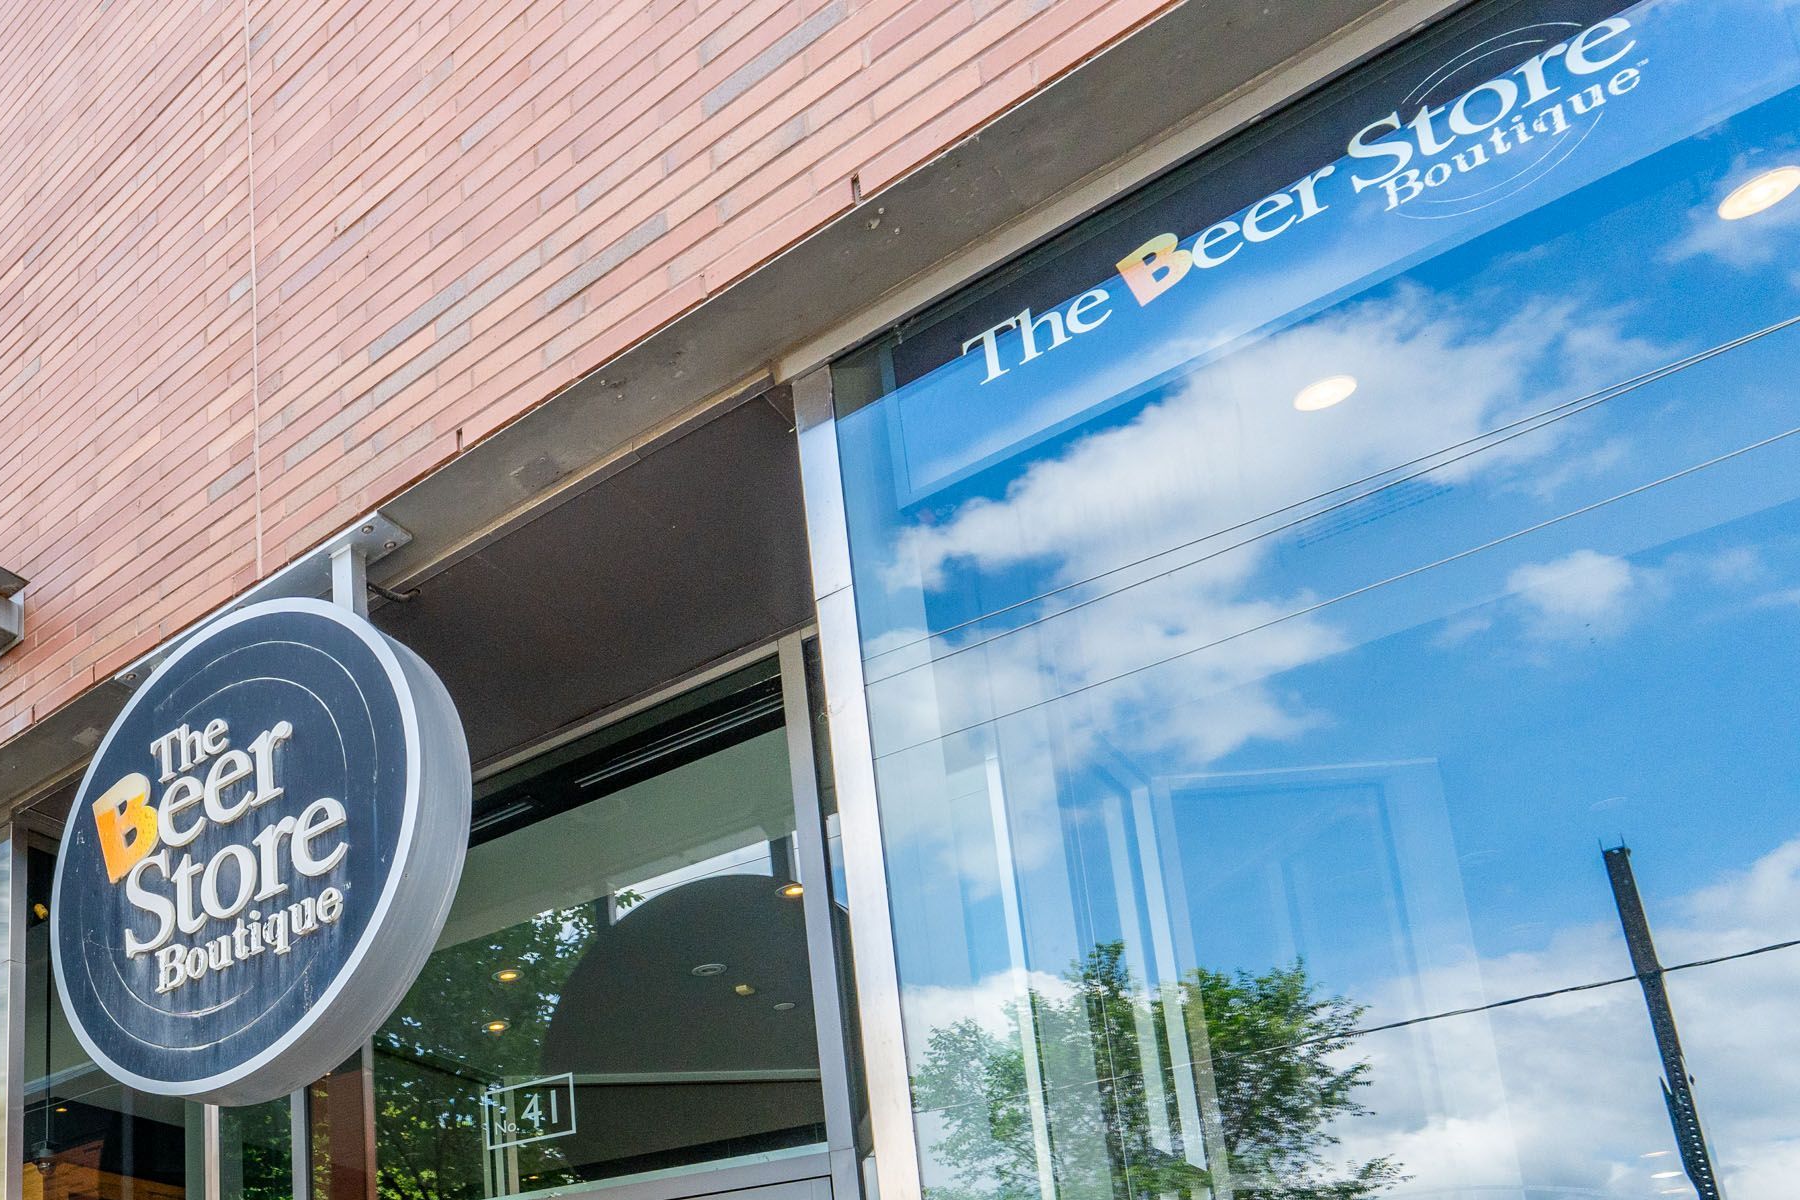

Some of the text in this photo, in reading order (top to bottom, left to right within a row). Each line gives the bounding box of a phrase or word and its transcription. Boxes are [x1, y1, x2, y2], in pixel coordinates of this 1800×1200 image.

[963, 15, 1637, 386] The Beer Store
[1380, 64, 1643, 212] Boutique
[92, 720, 294, 885] Beer
[150, 717, 229, 784] The
[123, 797, 349, 960] Store
[155, 885, 344, 994] Boutique
[495, 1089, 559, 1136] No. 41
